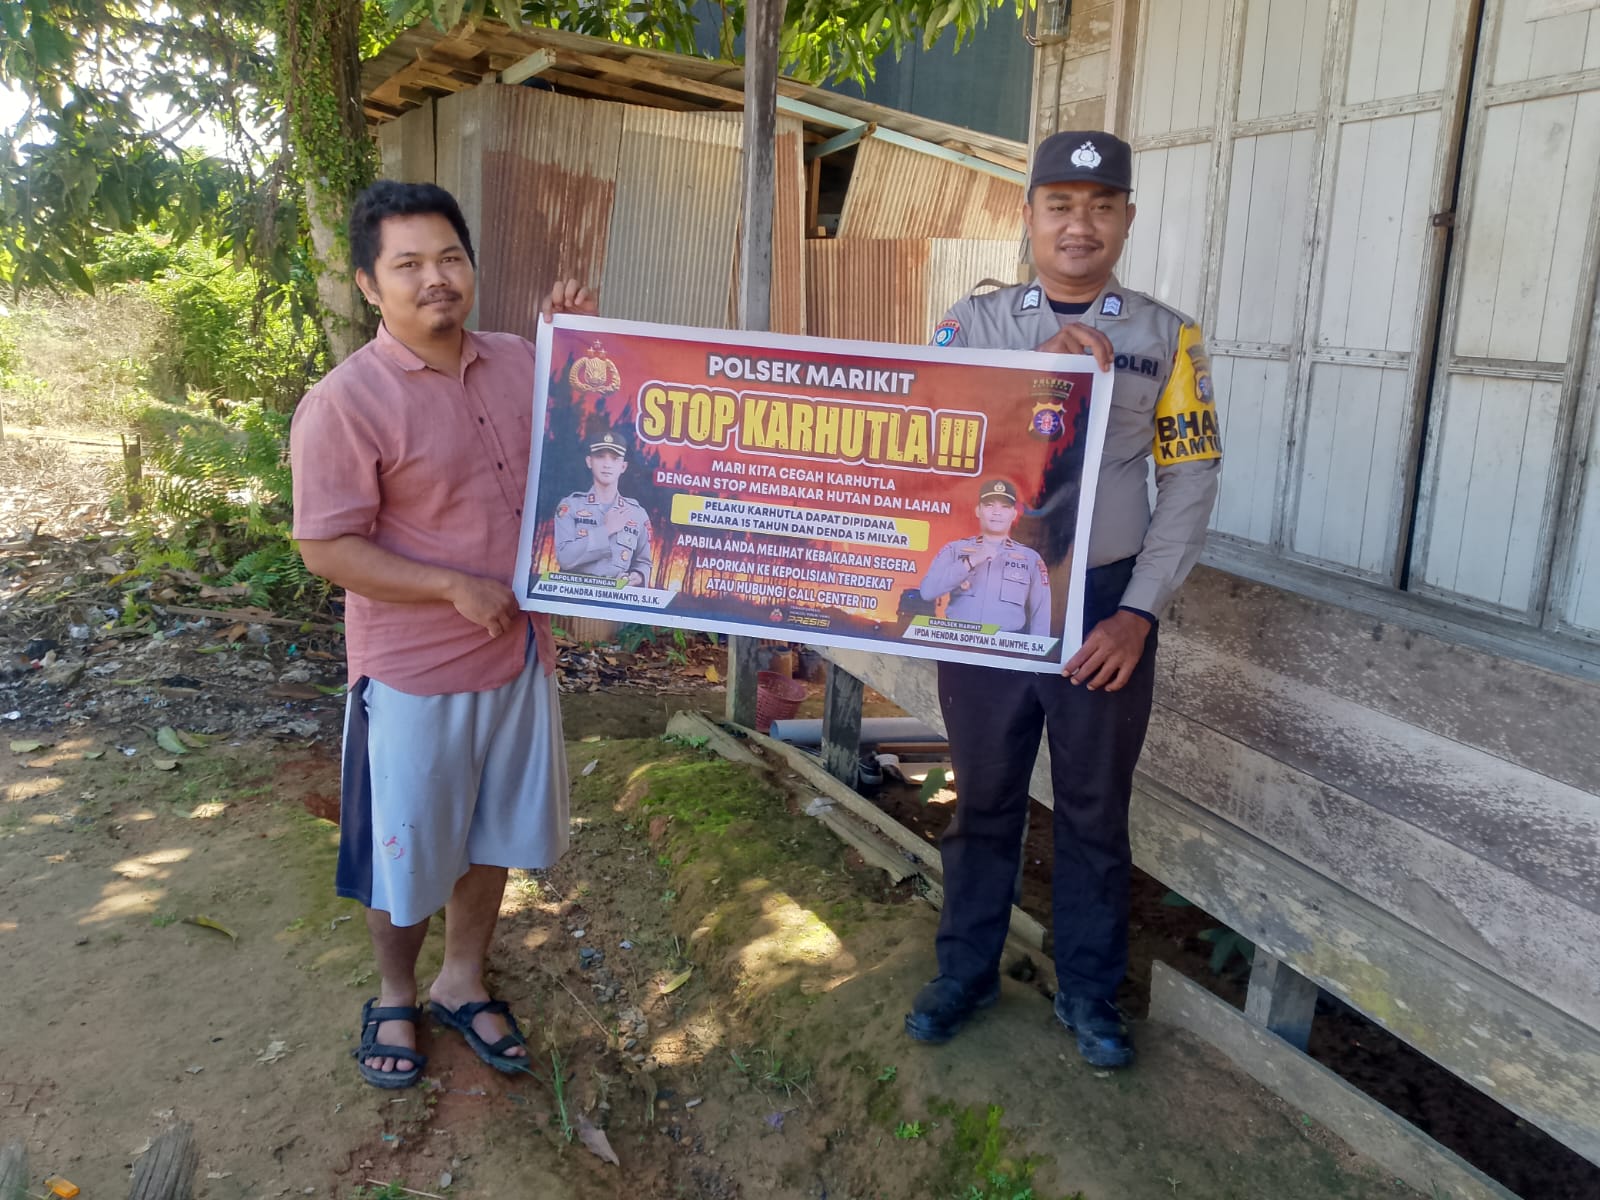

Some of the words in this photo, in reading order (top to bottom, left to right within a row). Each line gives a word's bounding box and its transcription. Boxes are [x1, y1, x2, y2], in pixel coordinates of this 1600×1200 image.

[709, 355, 801, 385] POLSEK
[806, 365, 914, 394] MARIKIT
[1114, 354, 1158, 376] OLRI
[642, 387, 736, 442] STOP
[742, 398, 929, 464] KARHUTLA
[937, 417, 979, 469] !!!
[712, 460, 745, 475] MARI
[748, 463, 776, 478] KITA
[780, 467, 823, 483] CEGAH
[827, 472, 896, 491] KARHUTLA
[656, 471, 711, 488] DENGAN
[713, 477, 747, 492] STOP
[749, 481, 823, 501] MEMBAKAR
[827, 490, 870, 506] HUTAN
[873, 495, 902, 509] DAN
[905, 498, 951, 514] LAHAN
[690, 512, 739, 527] PENJARA
[741, 518, 751, 528] 15
[754, 519, 789, 533] TAHUN
[791, 524, 814, 535] DAN
[816, 527, 853, 540] DENDA
[855, 531, 865, 541] 15
[868, 532, 908, 546] MILYAR
[705, 500, 745, 514] PELAKU
[747, 506, 803, 521] KARHUTLA
[806, 512, 839, 525] DAPAT
[842, 516, 895, 531] DIPIDANA
[677, 534, 722, 551] APABILA
[723, 539, 755, 555] ANDA
[756, 543, 804, 560] MELIHAT
[805, 548, 872, 568] KEBAKARAN
[873, 556, 917, 573] SEGERA
[1004, 561, 1029, 570] POLRI
[696, 556, 754, 574] LAPORKAN
[757, 563, 770, 576] KE
[772, 565, 836, 584] KEPOLISIAN
[838, 572, 893, 590] TERDEKAT
[537, 583, 558, 593] AKBP
[560, 585, 594, 597] CHANDRA
[595, 589, 640, 604] ISMAWANTO,
[706, 577, 735, 592] ATAU
[736, 583, 787, 598] HUBUNGI
[788, 587, 815, 602] CALL
[817, 591, 860, 607] CENTER
[862, 596, 877, 610] 110
[914, 627, 930, 638] IPDA
[931, 629, 959, 641] HENDRA
[960, 633, 989, 645] SOPIYAN
[991, 637, 998, 646] D.
[999, 638, 1030, 651] MUNTHE,
